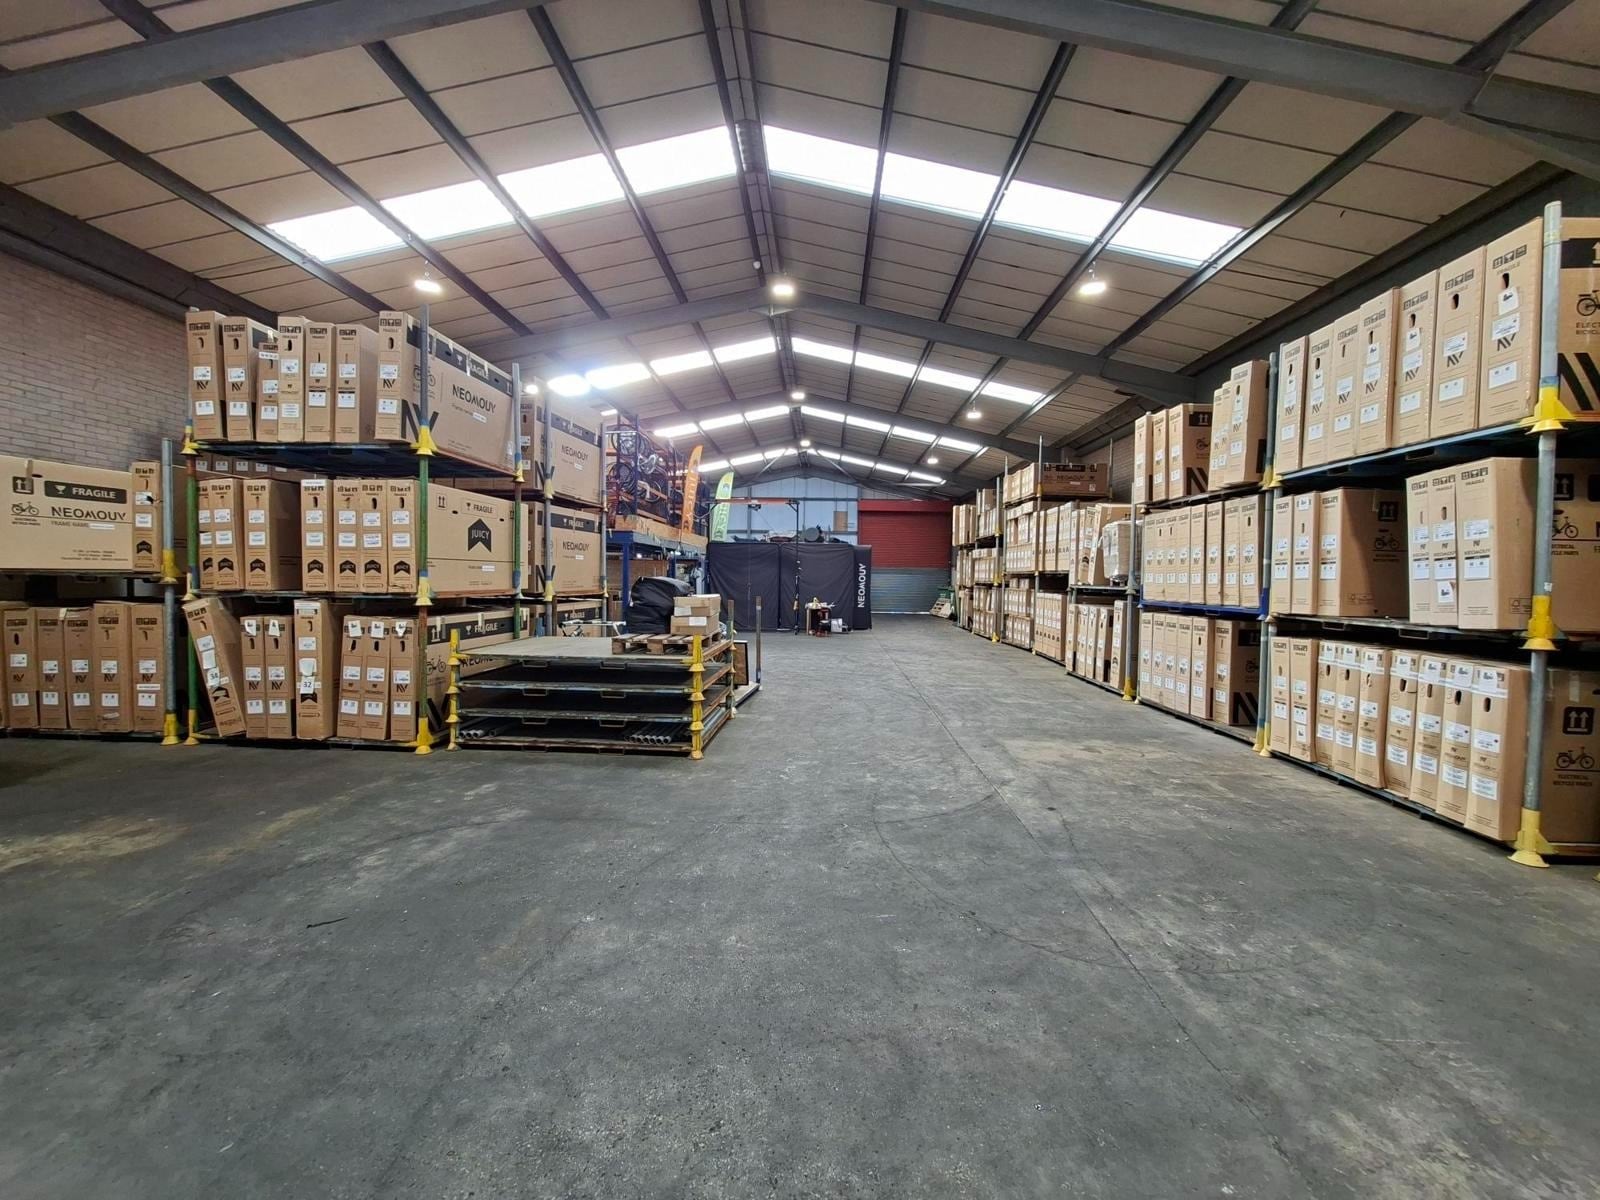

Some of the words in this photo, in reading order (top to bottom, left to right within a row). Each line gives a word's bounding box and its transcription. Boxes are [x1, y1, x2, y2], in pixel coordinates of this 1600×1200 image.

[71, 487, 117, 499] FRAGILE
[51, 506, 127, 521] NEOMOUV
[472, 503, 493, 514] FRAGILE
[471, 527, 490, 540] JUICY
[857, 563, 867, 608] NEOMOUV
